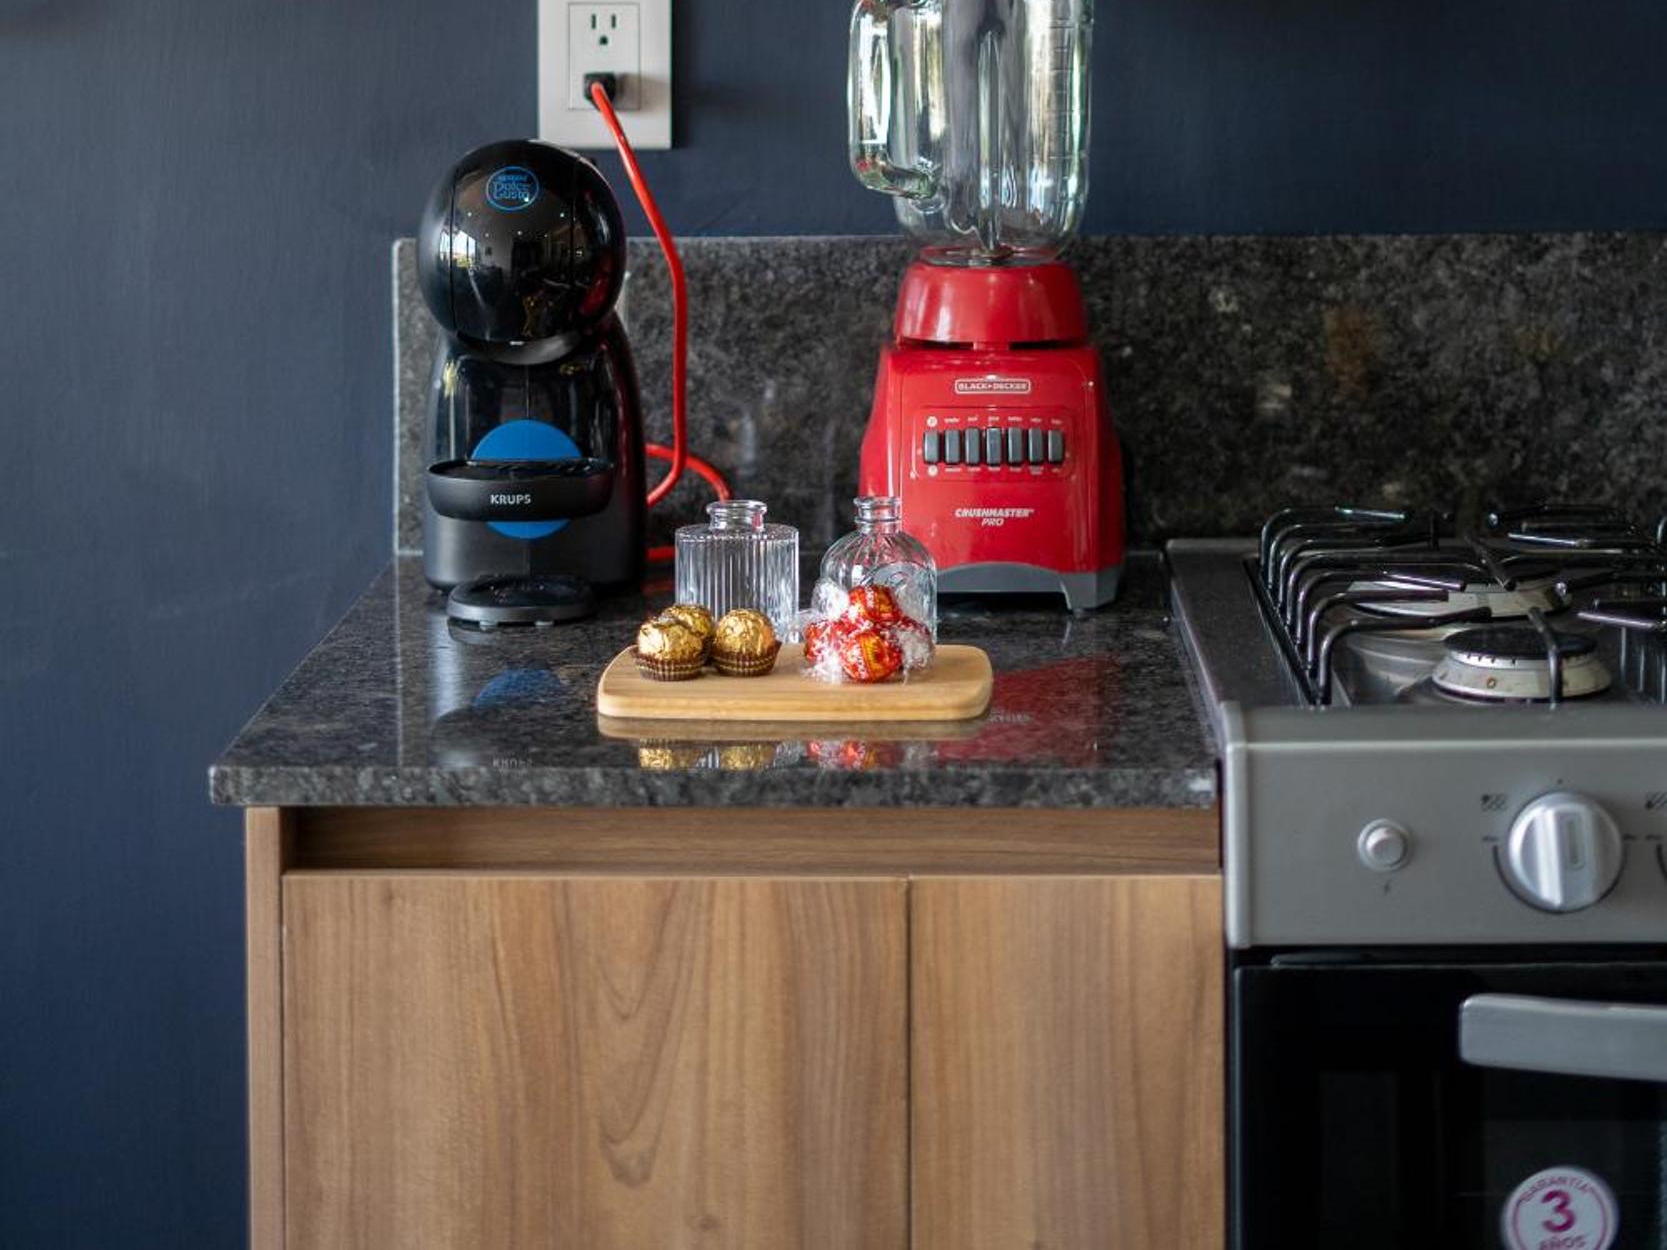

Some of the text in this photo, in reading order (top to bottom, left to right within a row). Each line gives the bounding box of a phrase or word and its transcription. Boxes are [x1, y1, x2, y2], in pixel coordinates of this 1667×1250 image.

[490, 494, 531, 505] KRUPS
[981, 518, 1005, 527] PRO
[1540, 1189, 1576, 1232] 3
